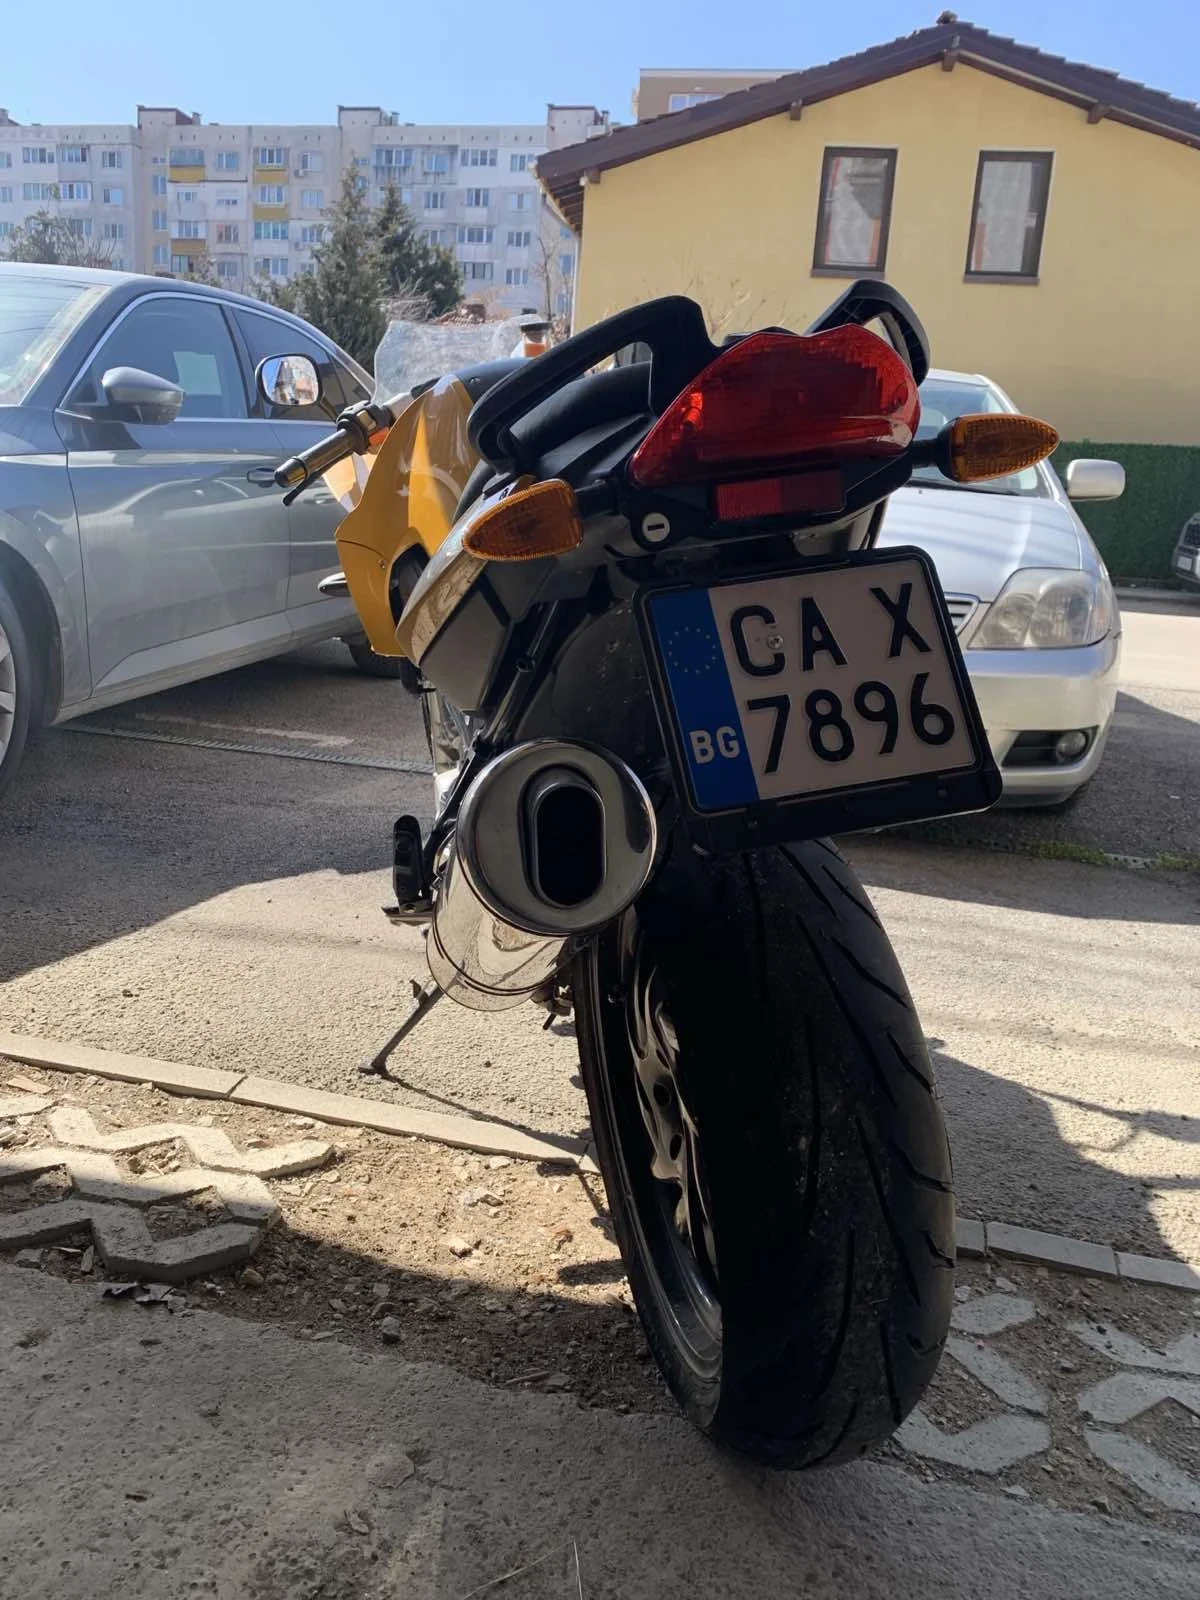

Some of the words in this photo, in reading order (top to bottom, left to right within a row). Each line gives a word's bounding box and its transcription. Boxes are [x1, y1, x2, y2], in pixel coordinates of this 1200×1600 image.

[730, 597, 848, 677] CA
[870, 582, 931, 658] X
[689, 726, 740, 764] BG
[747, 672, 955, 774] 7896
